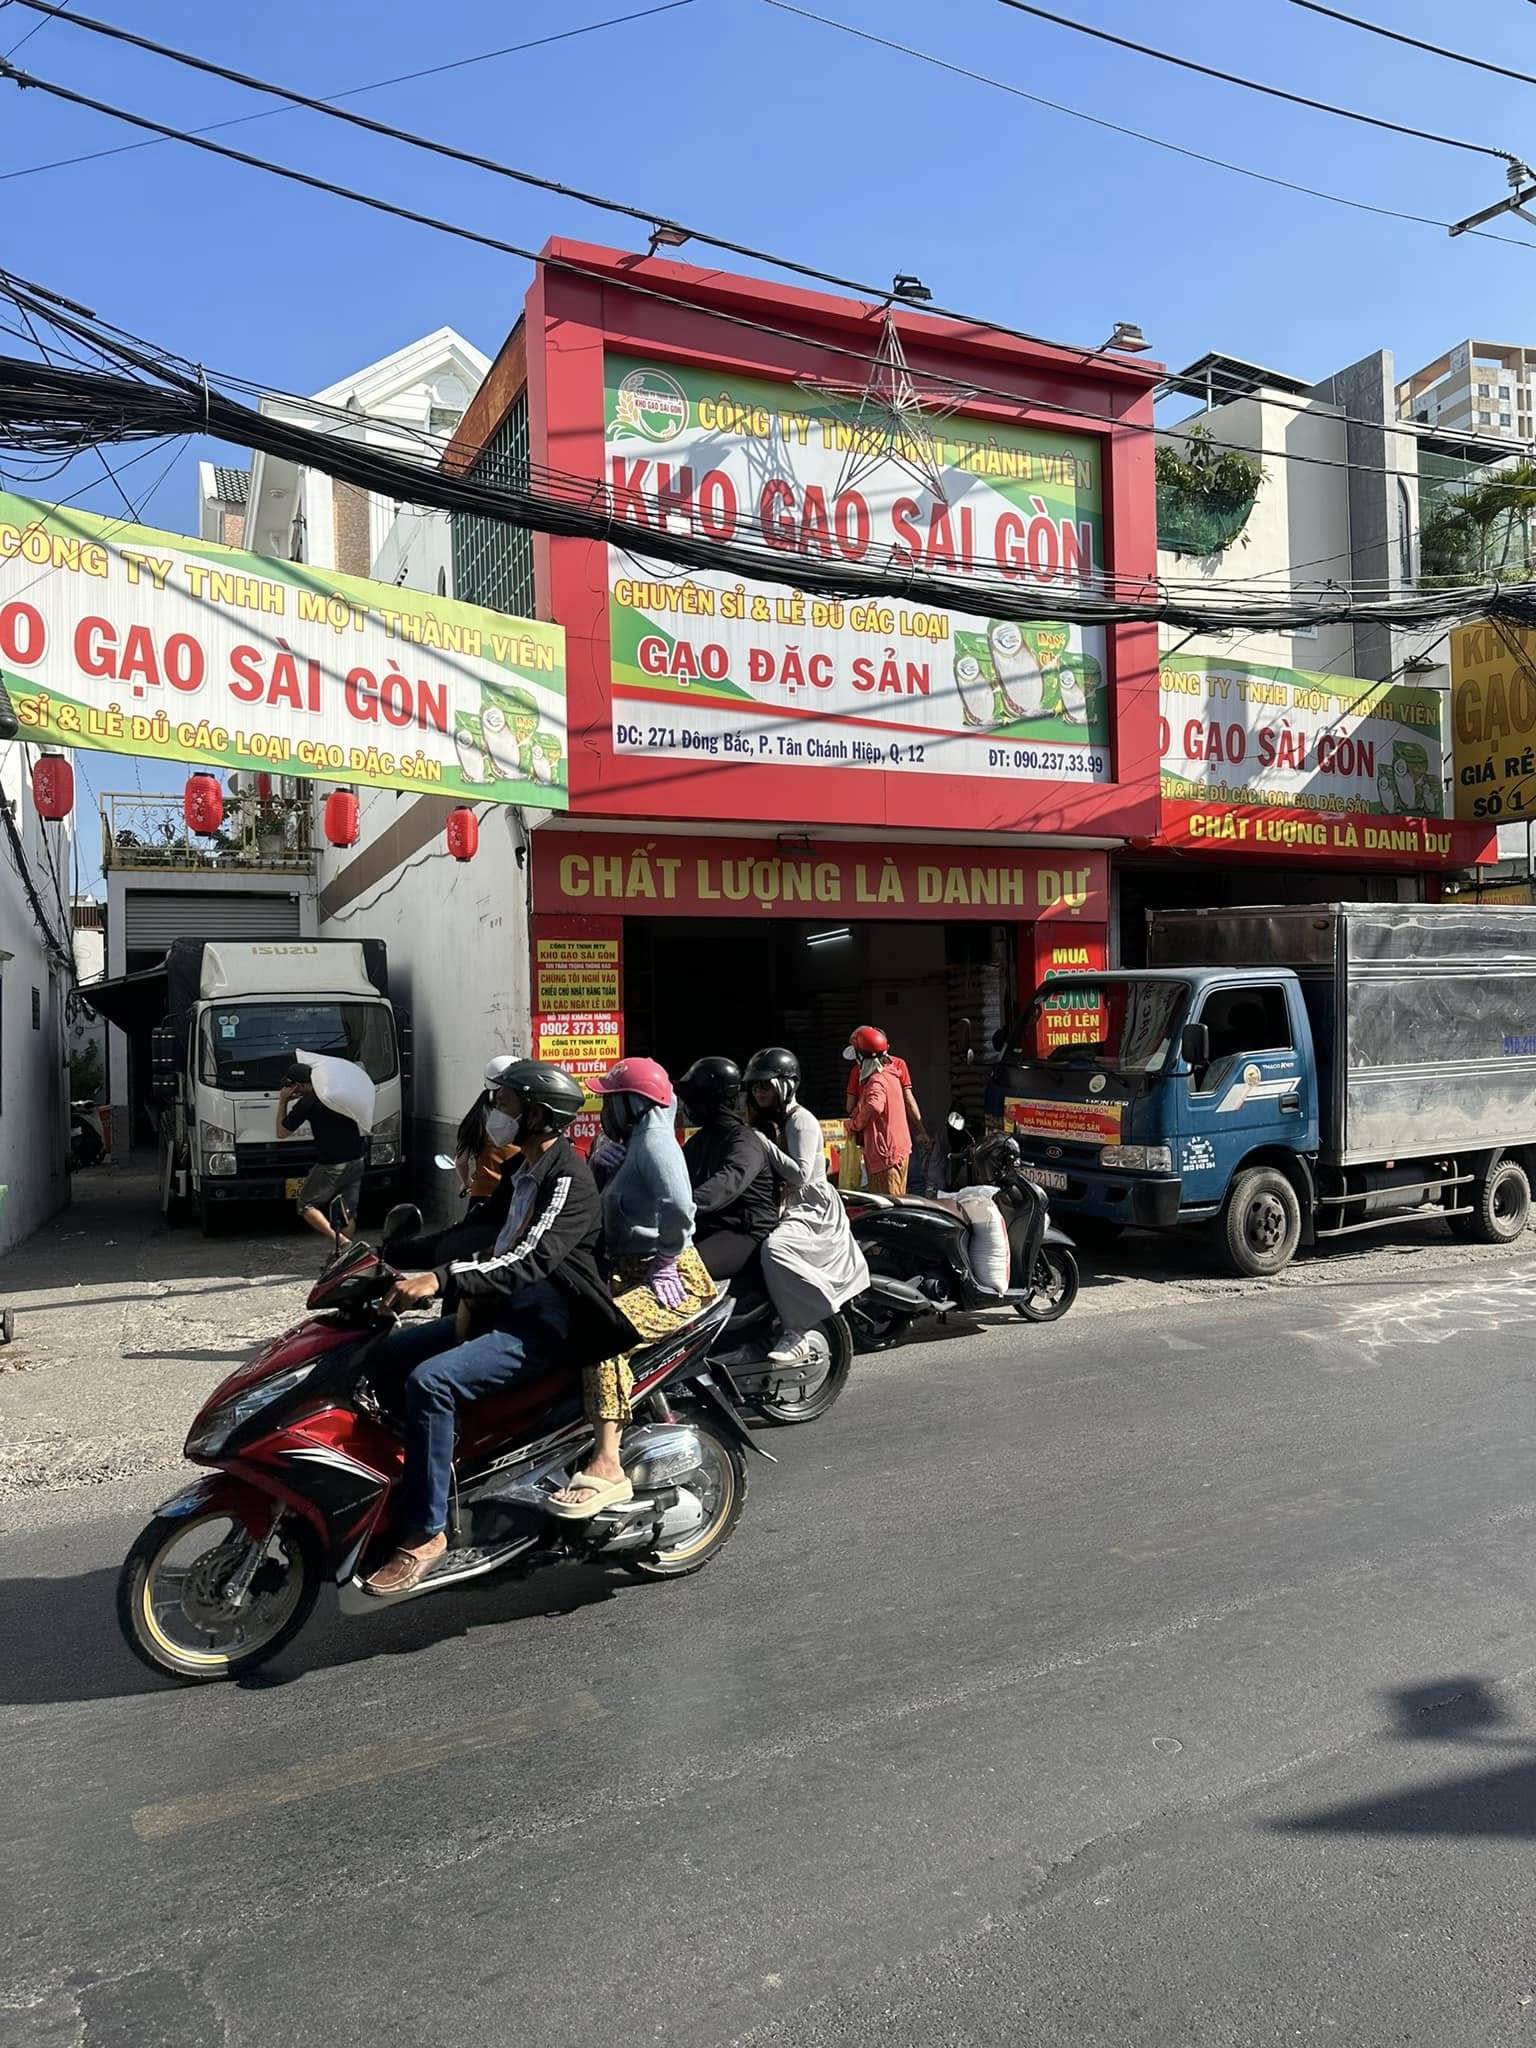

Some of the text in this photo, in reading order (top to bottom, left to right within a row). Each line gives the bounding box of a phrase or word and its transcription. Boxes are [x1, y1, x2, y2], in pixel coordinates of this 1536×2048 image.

[698, 391, 771, 440] CÔNG
[776, 408, 811, 446] TY
[818, 417, 886, 457] TNHH
[954, 436, 1034, 481] THÀNH
[1040, 450, 1093, 490] VIÊN
[612, 455, 737, 544] KHO
[994, 496, 1093, 588] GÒN
[0, 521, 556, 673] CÔNG TY TNHH MỘT THÀNH VIÊN
[614, 578, 715, 617] CHUYÊN
[720, 583, 746, 619] SỈ
[751, 595, 771, 622] &
[776, 590, 806, 626] LẺ
[850, 601, 894, 634] CÁC
[900, 610, 949, 644] LOẠI
[74, 615, 207, 699] GẠO
[228, 637, 323, 714] SÀI
[344, 658, 449, 734] GÒN
[638, 636, 931, 696] GẠO ĐẶC SẢN
[1205, 676, 1232, 699] TY
[1236, 680, 1288, 707] TNHH
[1293, 686, 1331, 715] MỘT
[1400, 703, 1437, 726] VIÊN
[1456, 665, 1536, 753] GẠO
[18, 692, 442, 782] SỈ & LẺ ĐỦ CÁC LOẠI GẠO ĐẶC SẢN
[616, 724, 925, 765] ĐC: 271 Đông Bắc, P. Tân Chánh Hiệp, Q. 12
[1183, 718, 1246, 772] GẠO
[1257, 718, 1306, 771] SÀI
[1317, 727, 1374, 778] GÒN
[988, 748, 1104, 773] ĐT: 090.237.33.99
[1461, 746, 1536, 786] GIÁ RẺ
[1175, 782, 1185, 798] &
[1189, 778, 1206, 800] LẺ
[1209, 780, 1228, 801] ĐỦ
[1231, 784, 1257, 804] CÁC
[1473, 786, 1525, 818] SỐ 1
[1189, 810, 1452, 858] CHẤT LƯỢNG LÀ DANH DỰ
[559, 843, 1091, 915] CHẤT LƯỢNG LÀ DANH DỰ
[251, 945, 319, 956] ISUZU
[540, 951, 559, 960] KHO
[1052, 948, 1090, 964] MUA
[540, 1021, 618, 1036] 0902 373 399
[1046, 1012, 1100, 1027] TRỞ LÊN
[1046, 1030, 1069, 1045] TÍNH
[1071, 1030, 1087, 1043] GIÁ
[542, 1048, 559, 1057] KHO
[574, 1123, 596, 1138] 643
